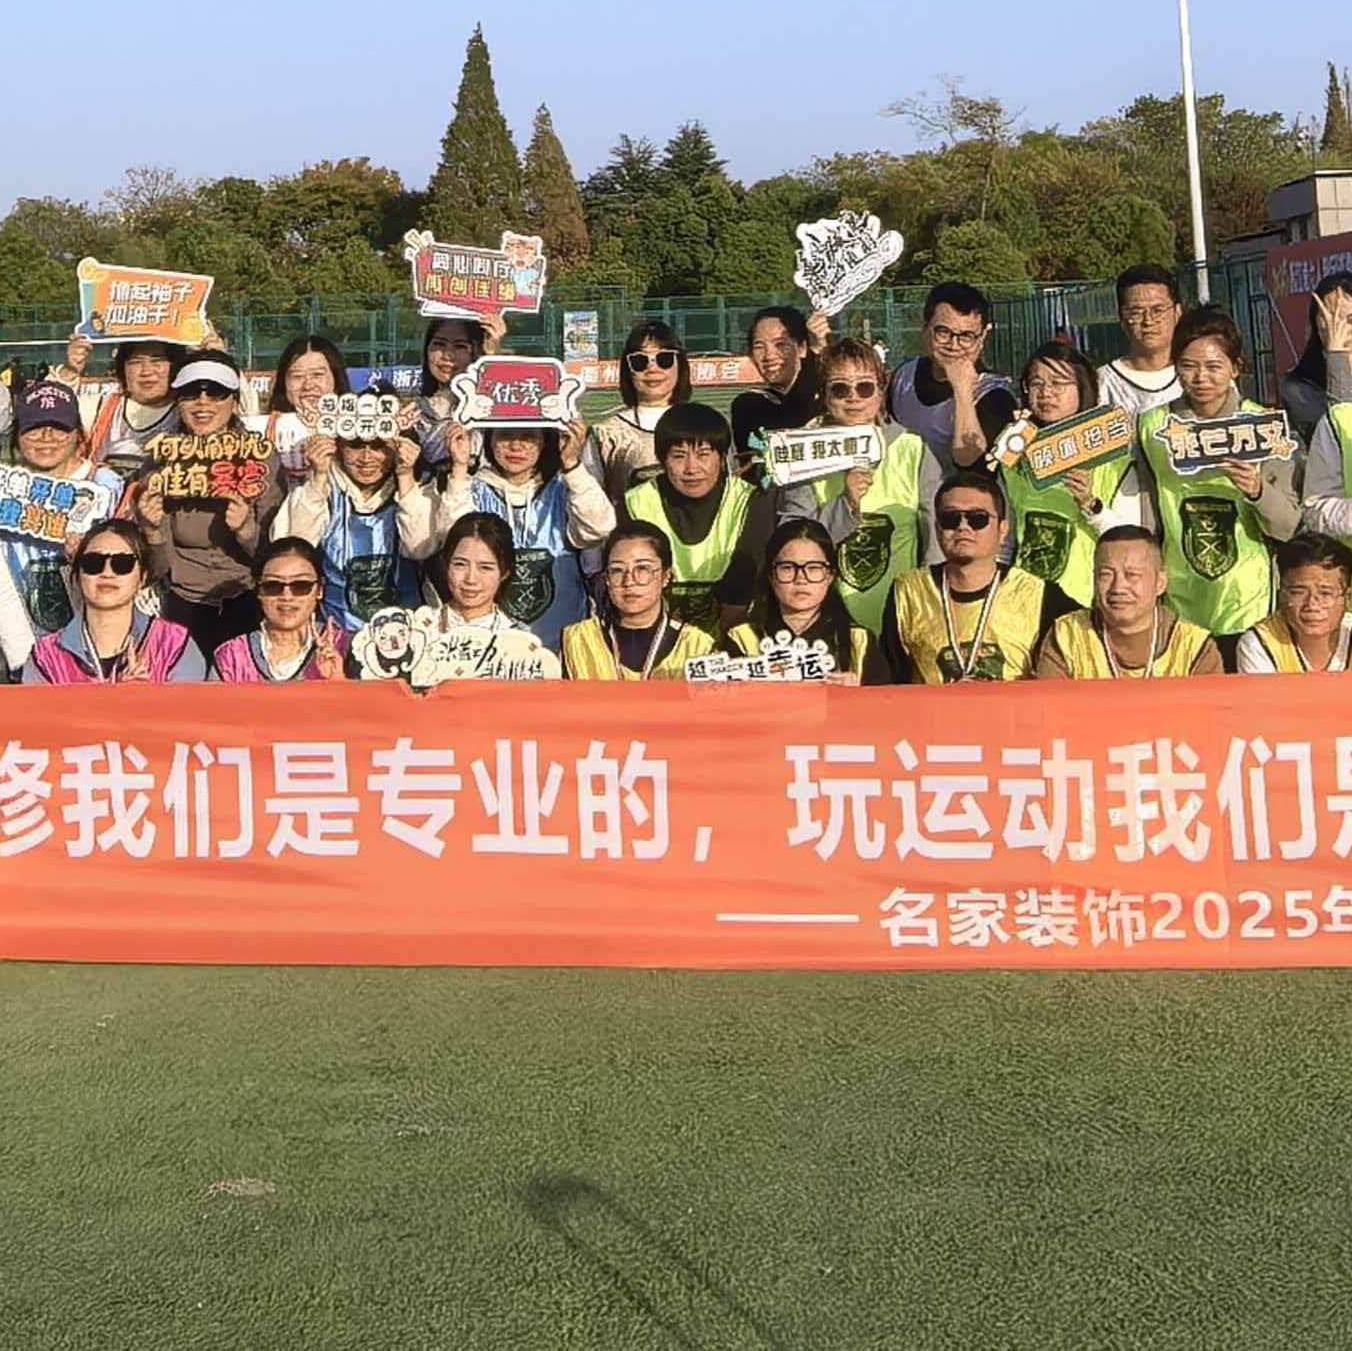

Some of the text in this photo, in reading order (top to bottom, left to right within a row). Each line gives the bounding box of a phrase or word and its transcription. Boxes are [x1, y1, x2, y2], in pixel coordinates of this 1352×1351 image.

[492, 378, 542, 406] 优秀
[143, 431, 273, 461] 何以解忧
